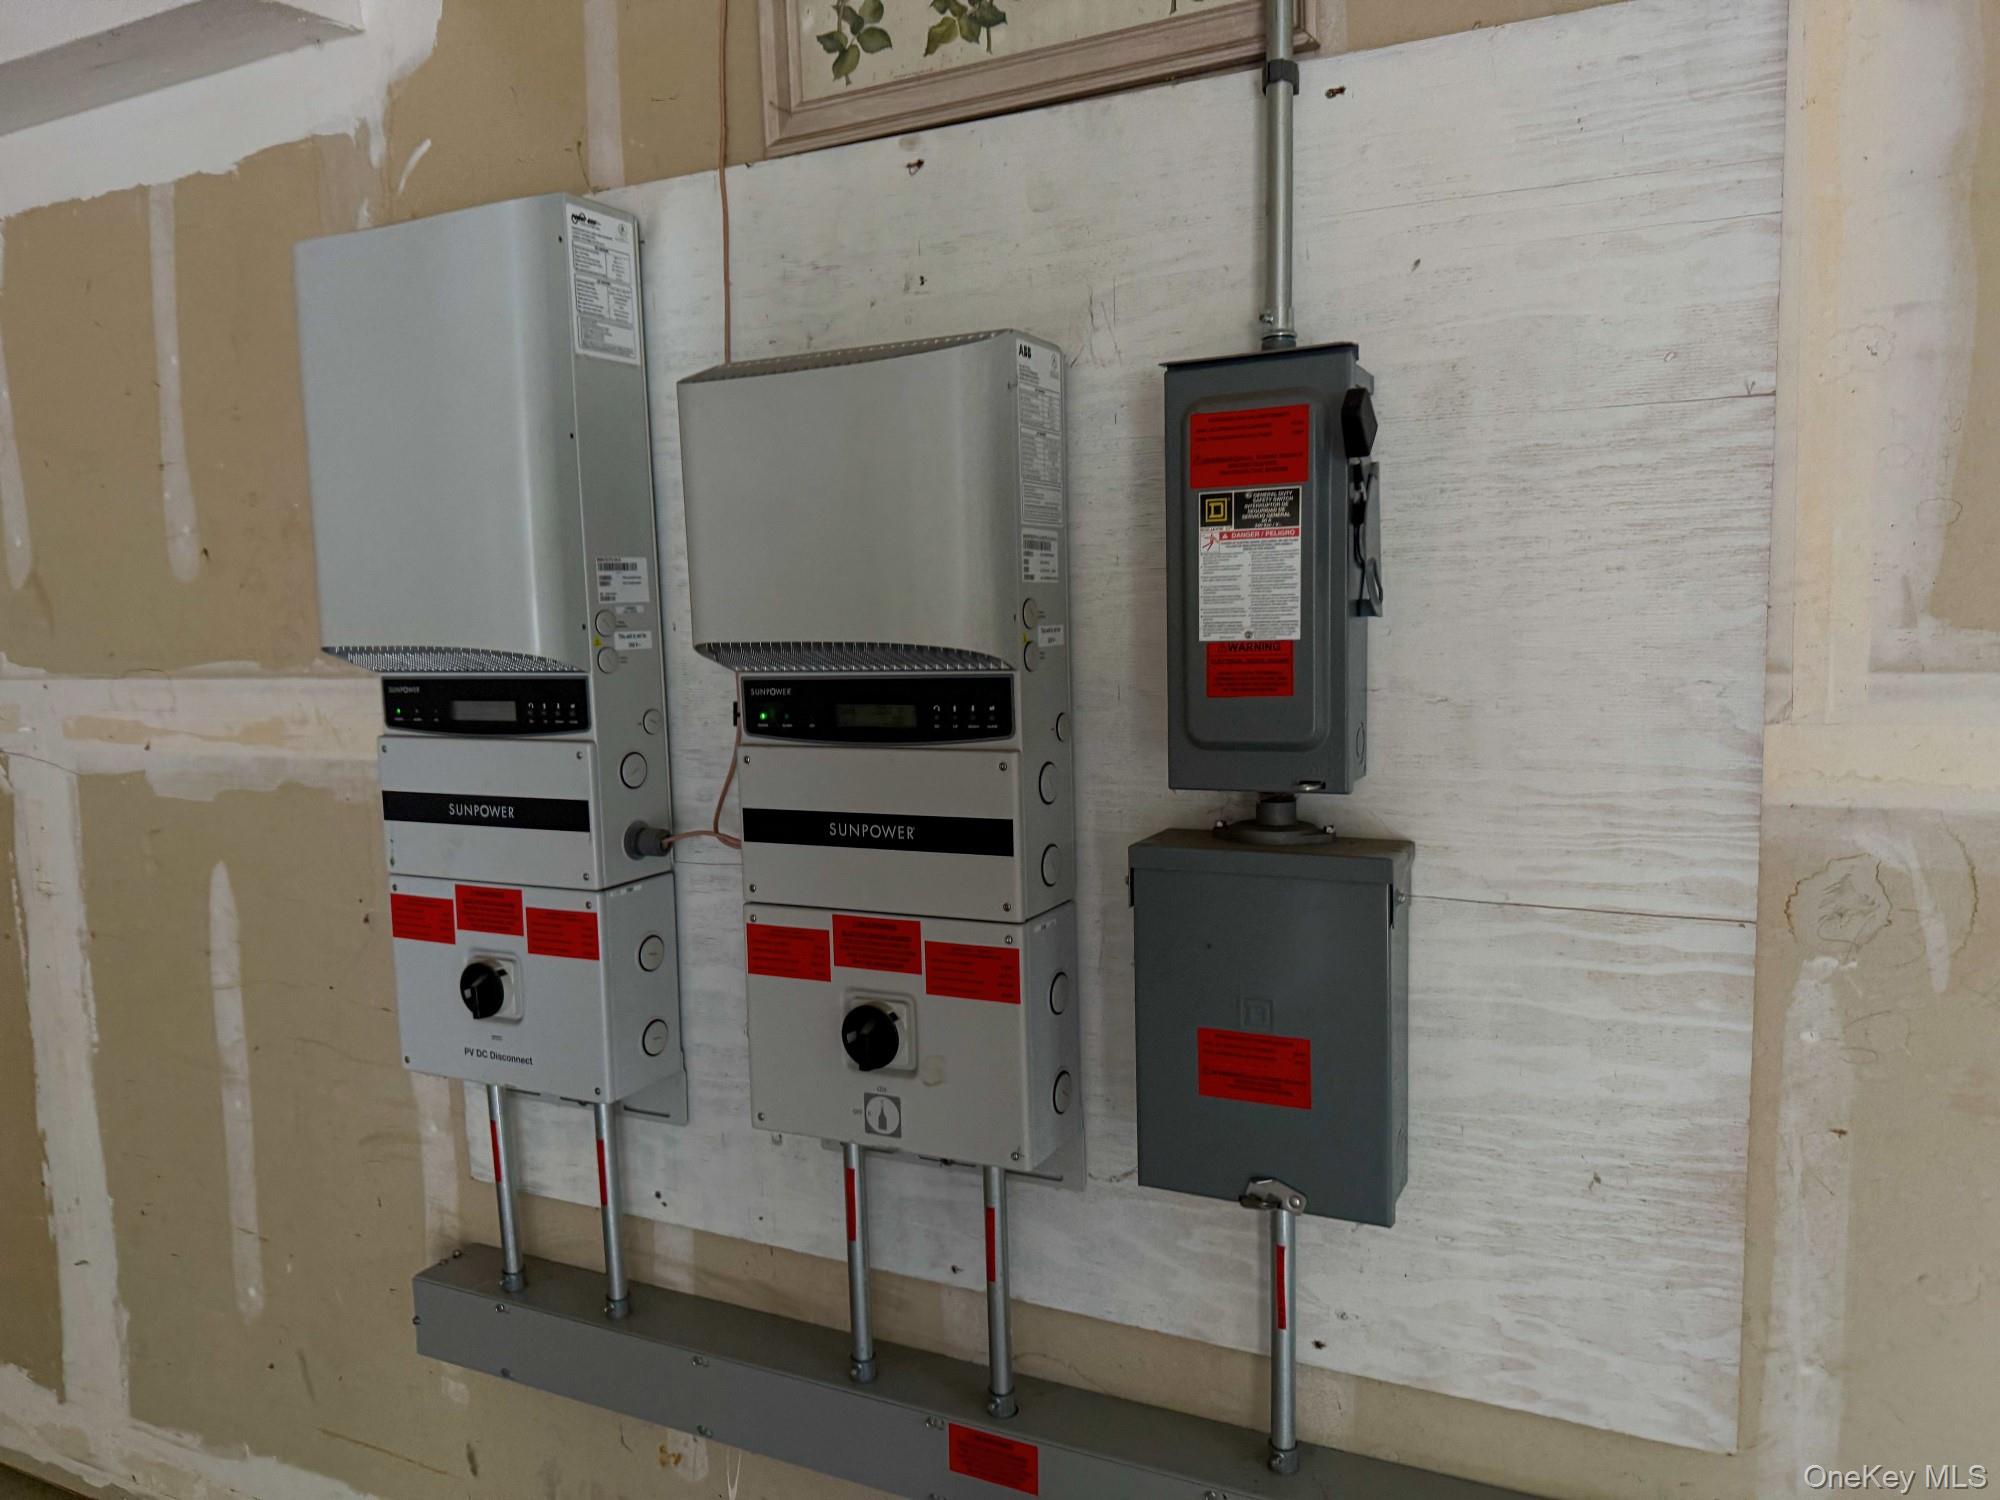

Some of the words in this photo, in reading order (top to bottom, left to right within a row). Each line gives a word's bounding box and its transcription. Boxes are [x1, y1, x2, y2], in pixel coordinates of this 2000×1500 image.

[1019, 344, 1032, 359] ABB
[1227, 642, 1280, 651] WARNING
[750, 687, 793, 697] SUNPOWER
[448, 803, 515, 818] SUNPOWER
[829, 822, 916, 840] SUNPOWER
[464, 1047, 475, 1056] PV
[476, 1049, 488, 1058] DC
[489, 1051, 533, 1065] Disconnect
